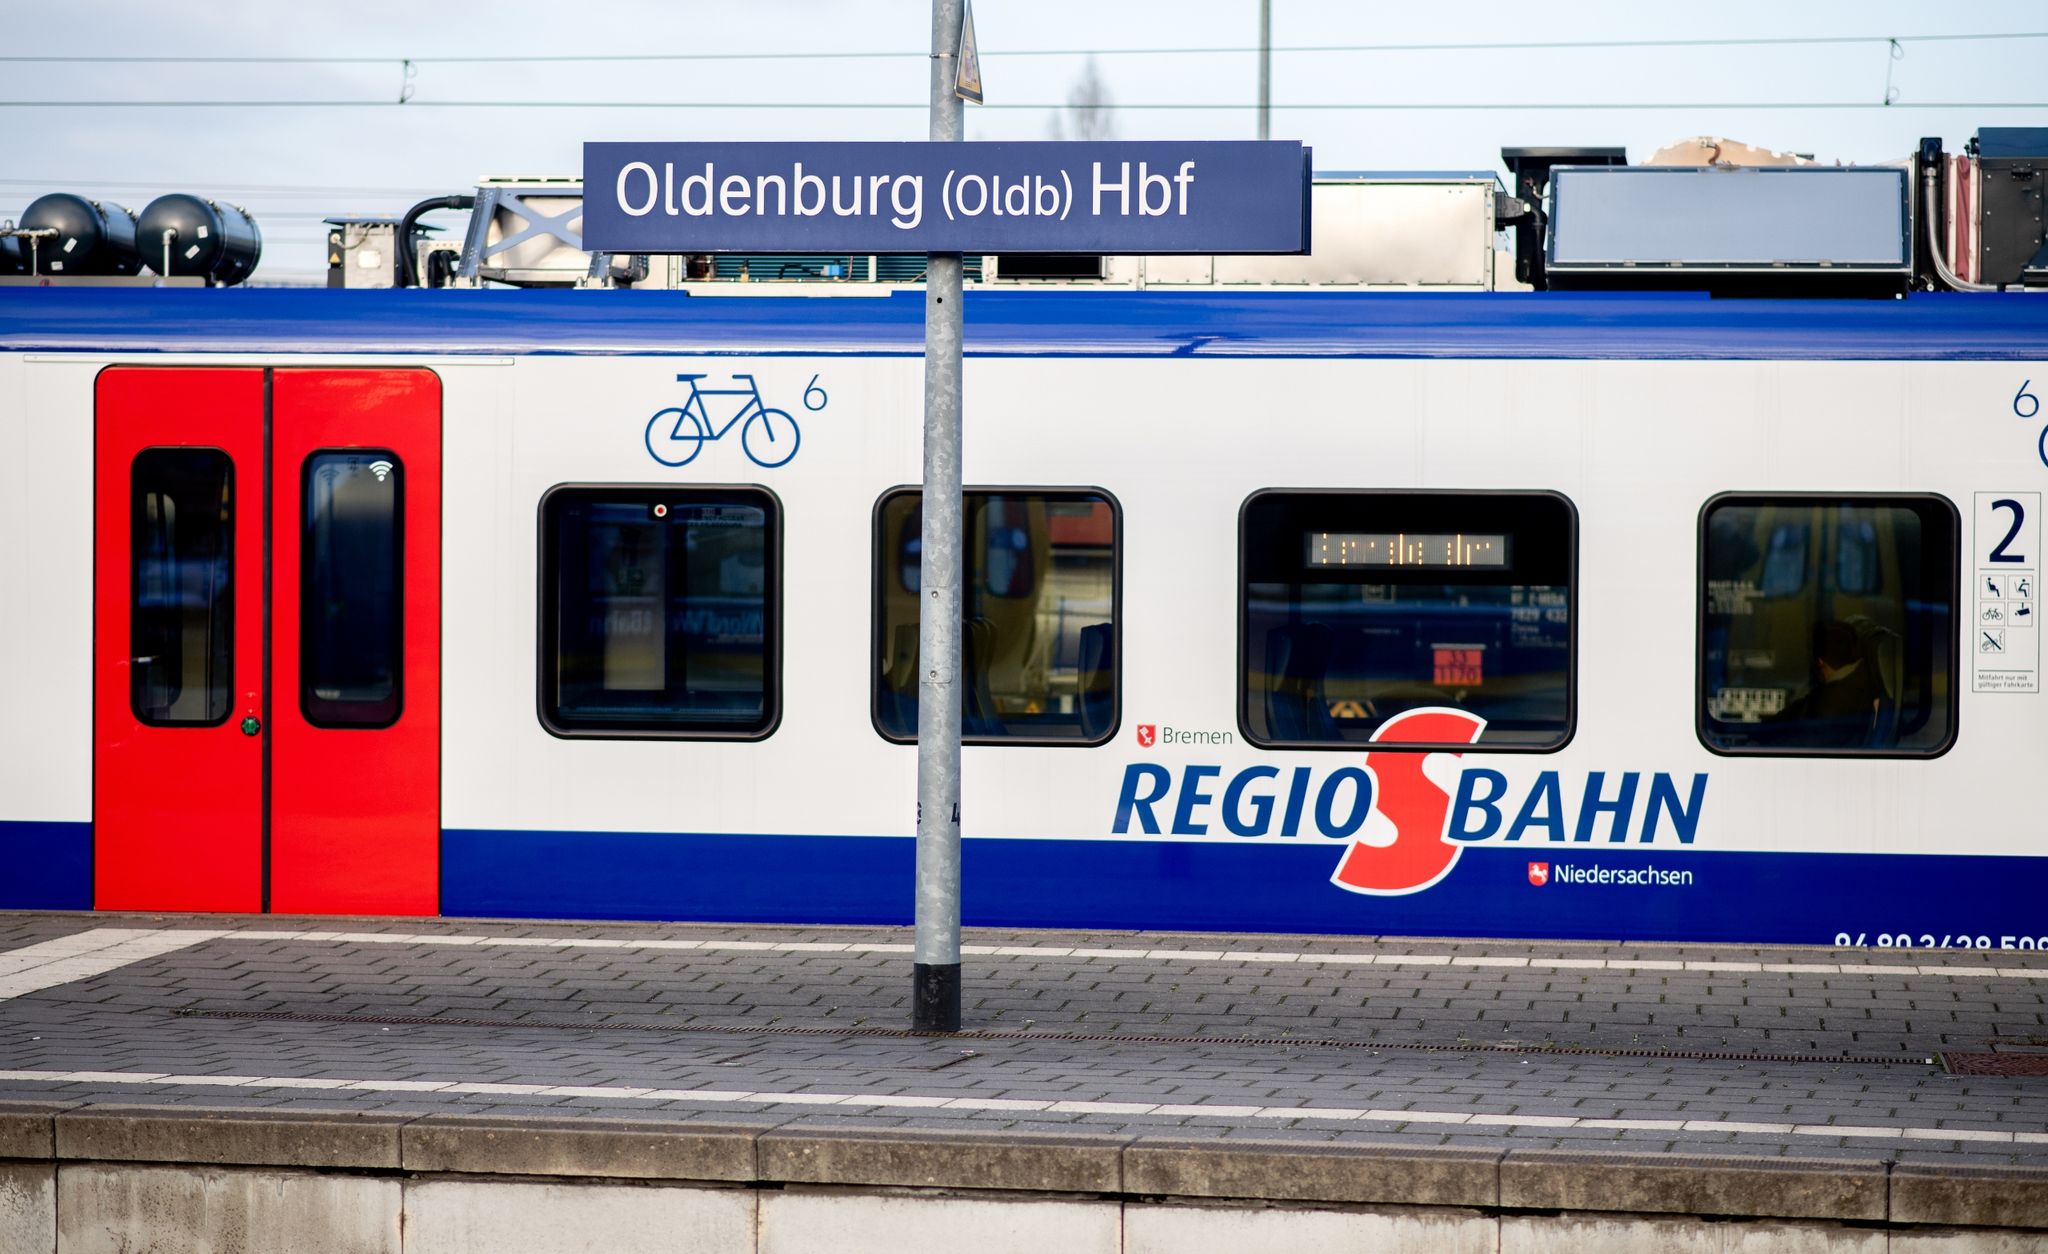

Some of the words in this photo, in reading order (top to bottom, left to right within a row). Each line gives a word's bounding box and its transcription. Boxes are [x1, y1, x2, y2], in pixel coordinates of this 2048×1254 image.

[616, 161, 923, 230] Oldenburg
[942, 169, 1073, 221] (Oldb)
[1092, 161, 1195, 217] Hbf
[803, 374, 828, 412] 6
[2013, 379, 2040, 418] 6
[1989, 498, 2025, 563] 2
[1977, 681, 2002, 689] gültiger
[1163, 726, 1233, 745] Bremen
[1554, 863, 1693, 886] Niedersachsen
